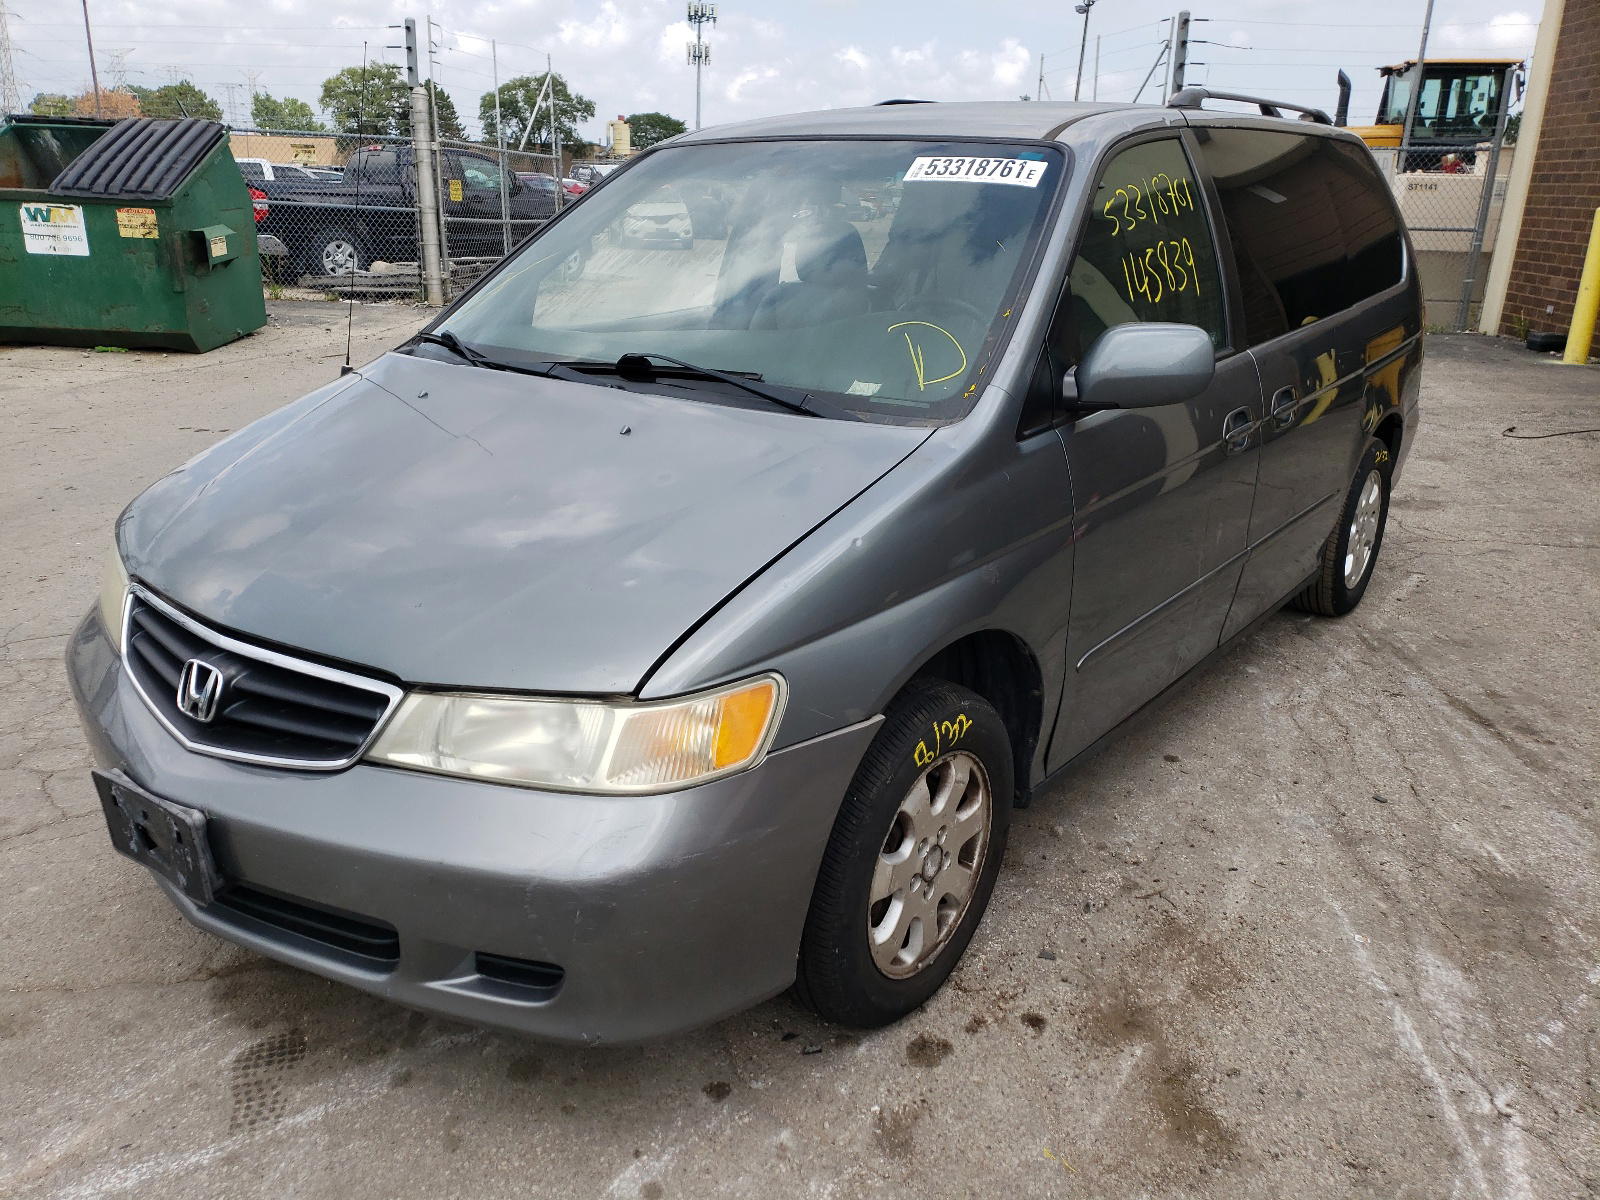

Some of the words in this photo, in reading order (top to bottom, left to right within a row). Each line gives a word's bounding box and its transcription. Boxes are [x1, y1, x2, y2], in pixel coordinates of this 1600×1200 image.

[925, 159, 1027, 179] 53318761
[1027, 169, 1036, 180] E
[1407, 183, 1438, 191] ST1141
[24, 206, 78, 223] WM
[1104, 173, 1194, 236] 53318761
[1122, 237, 1200, 303] 145839
